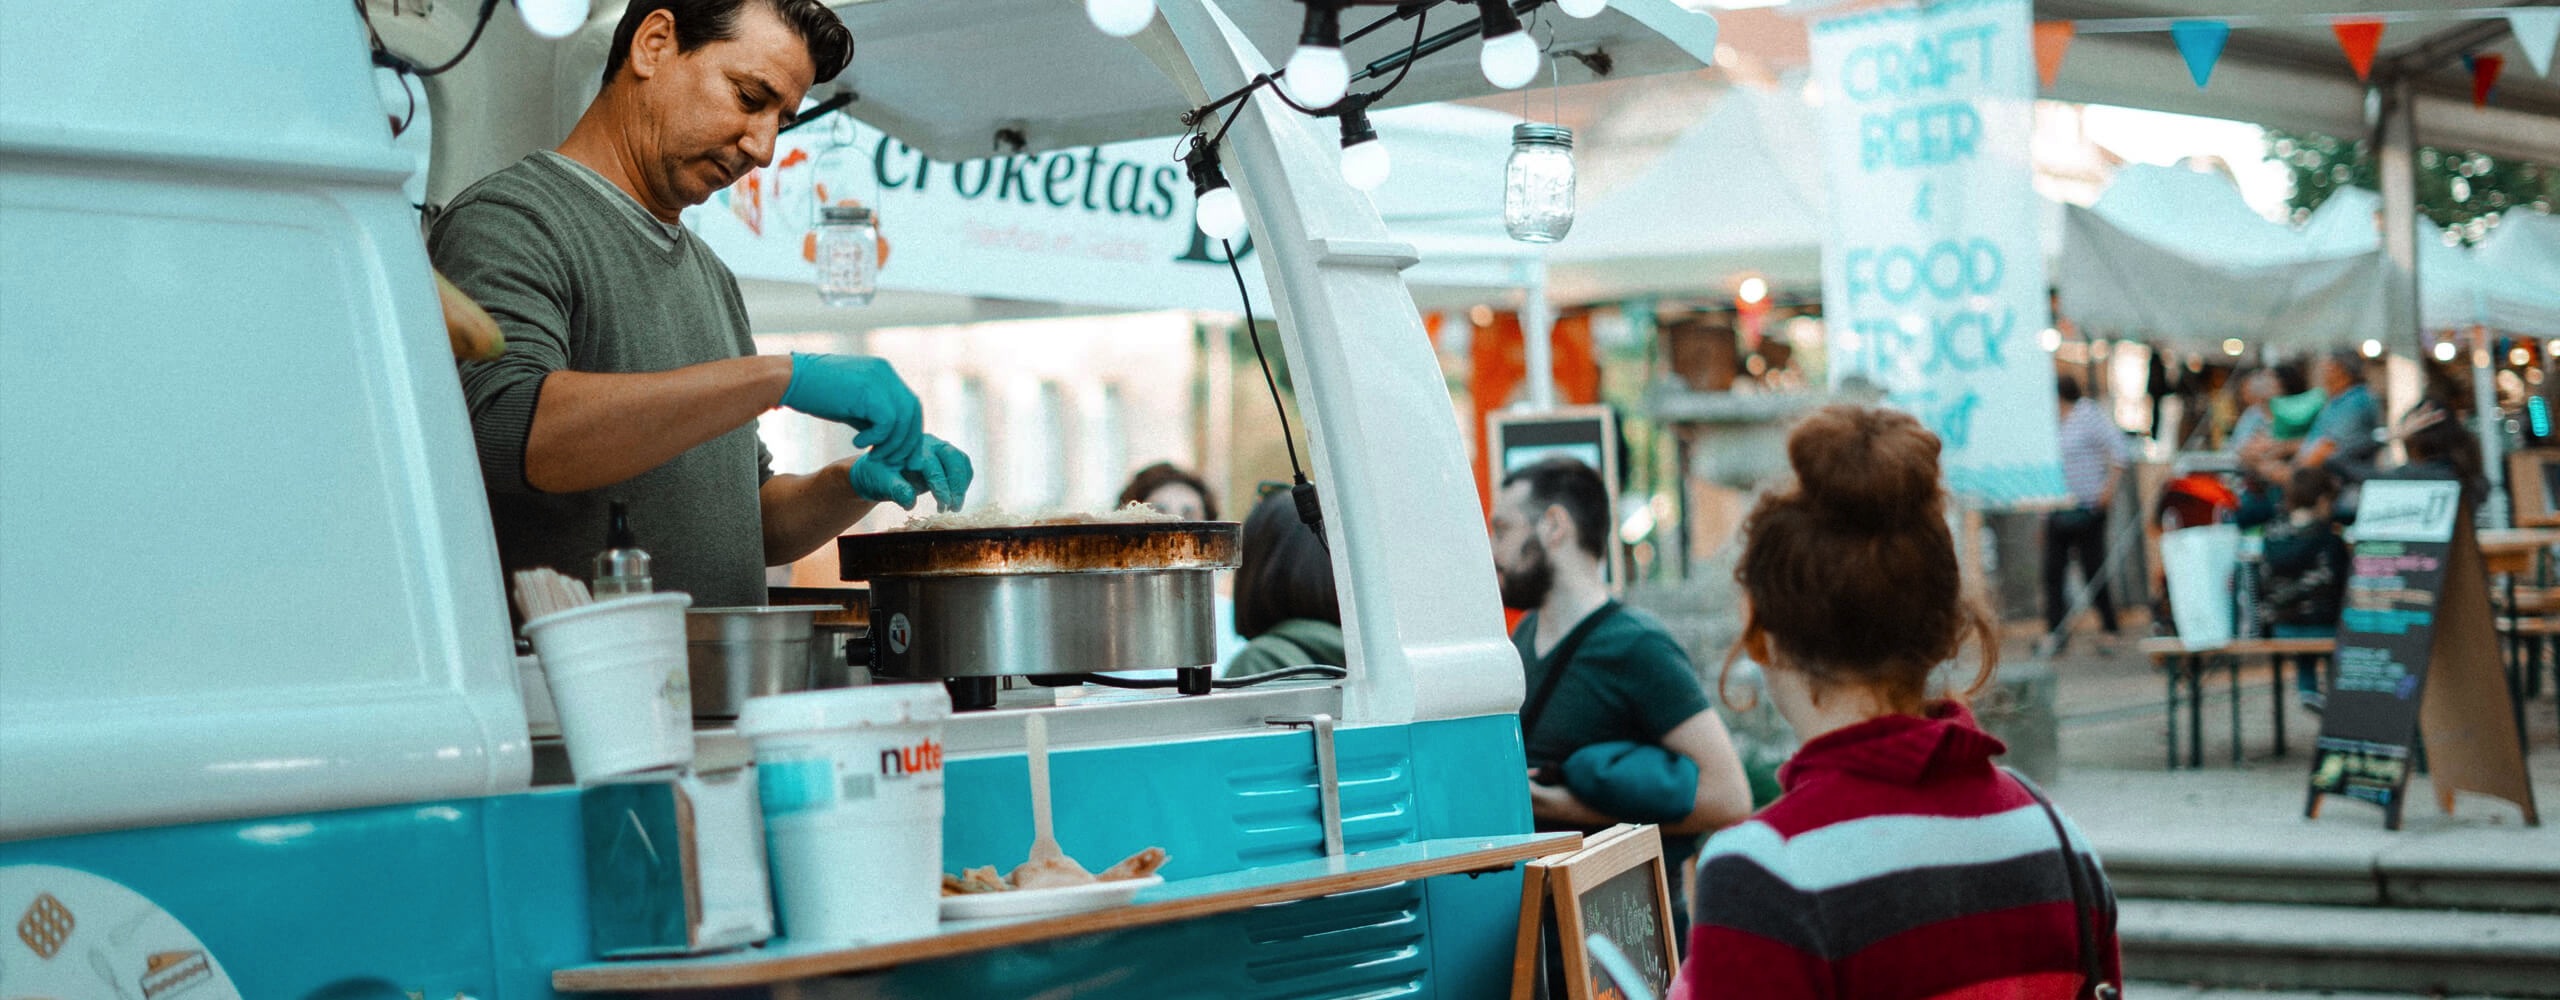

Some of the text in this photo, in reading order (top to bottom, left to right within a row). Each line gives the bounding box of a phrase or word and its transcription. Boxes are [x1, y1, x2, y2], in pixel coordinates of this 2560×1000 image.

[1842, 23, 1998, 99] CRAFT
[1862, 103, 1981, 170] BEER
[1847, 238, 2003, 305] FOOD
